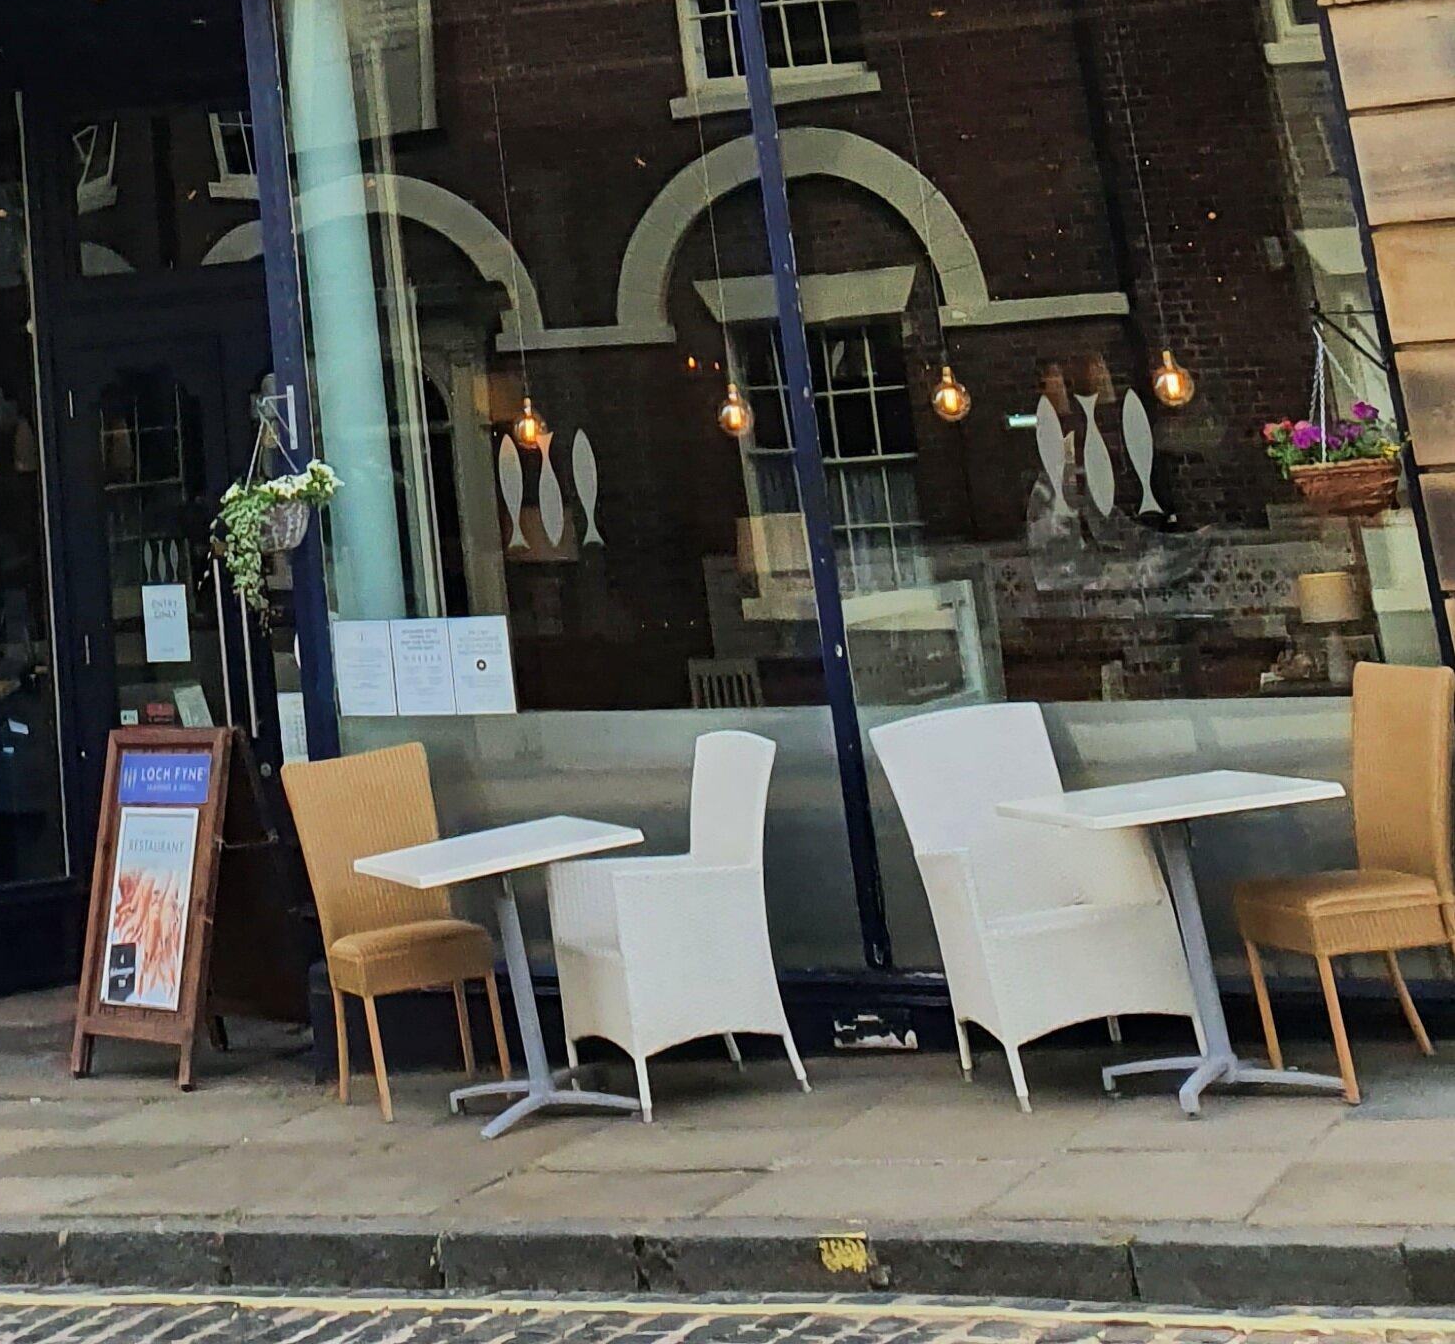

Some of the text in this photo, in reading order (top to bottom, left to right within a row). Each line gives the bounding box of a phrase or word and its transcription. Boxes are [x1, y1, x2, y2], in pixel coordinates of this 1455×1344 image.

[141, 766, 205, 782] LOCH FYNE
[128, 837, 185, 853] RESTAURANT
